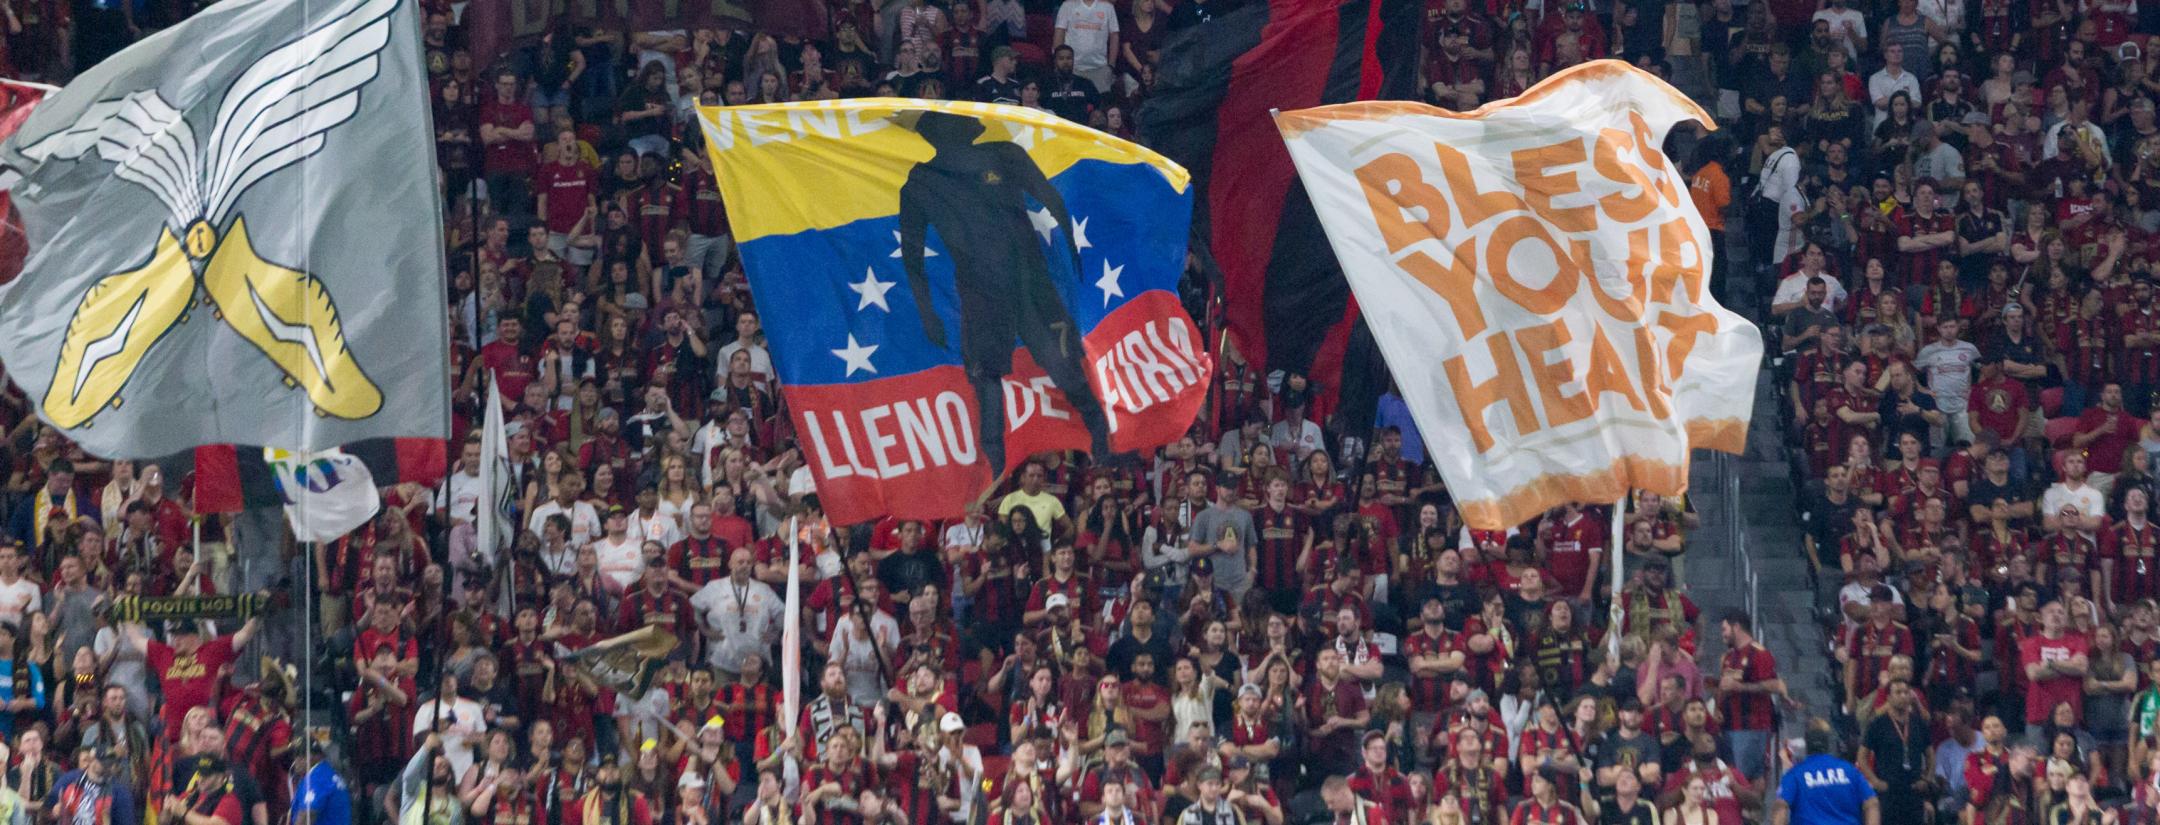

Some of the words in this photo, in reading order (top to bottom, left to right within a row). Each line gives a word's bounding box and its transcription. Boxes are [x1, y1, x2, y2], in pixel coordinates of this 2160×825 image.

[1354, 110, 1679, 254] BLESS
[1397, 217, 1703, 342] YOUR
[1050, 321, 1068, 358] 7
[804, 391, 976, 479] LLENO
[1002, 376, 1070, 432] DE
[141, 600, 195, 614] FOOTIE
[201, 598, 234, 611] MOB
